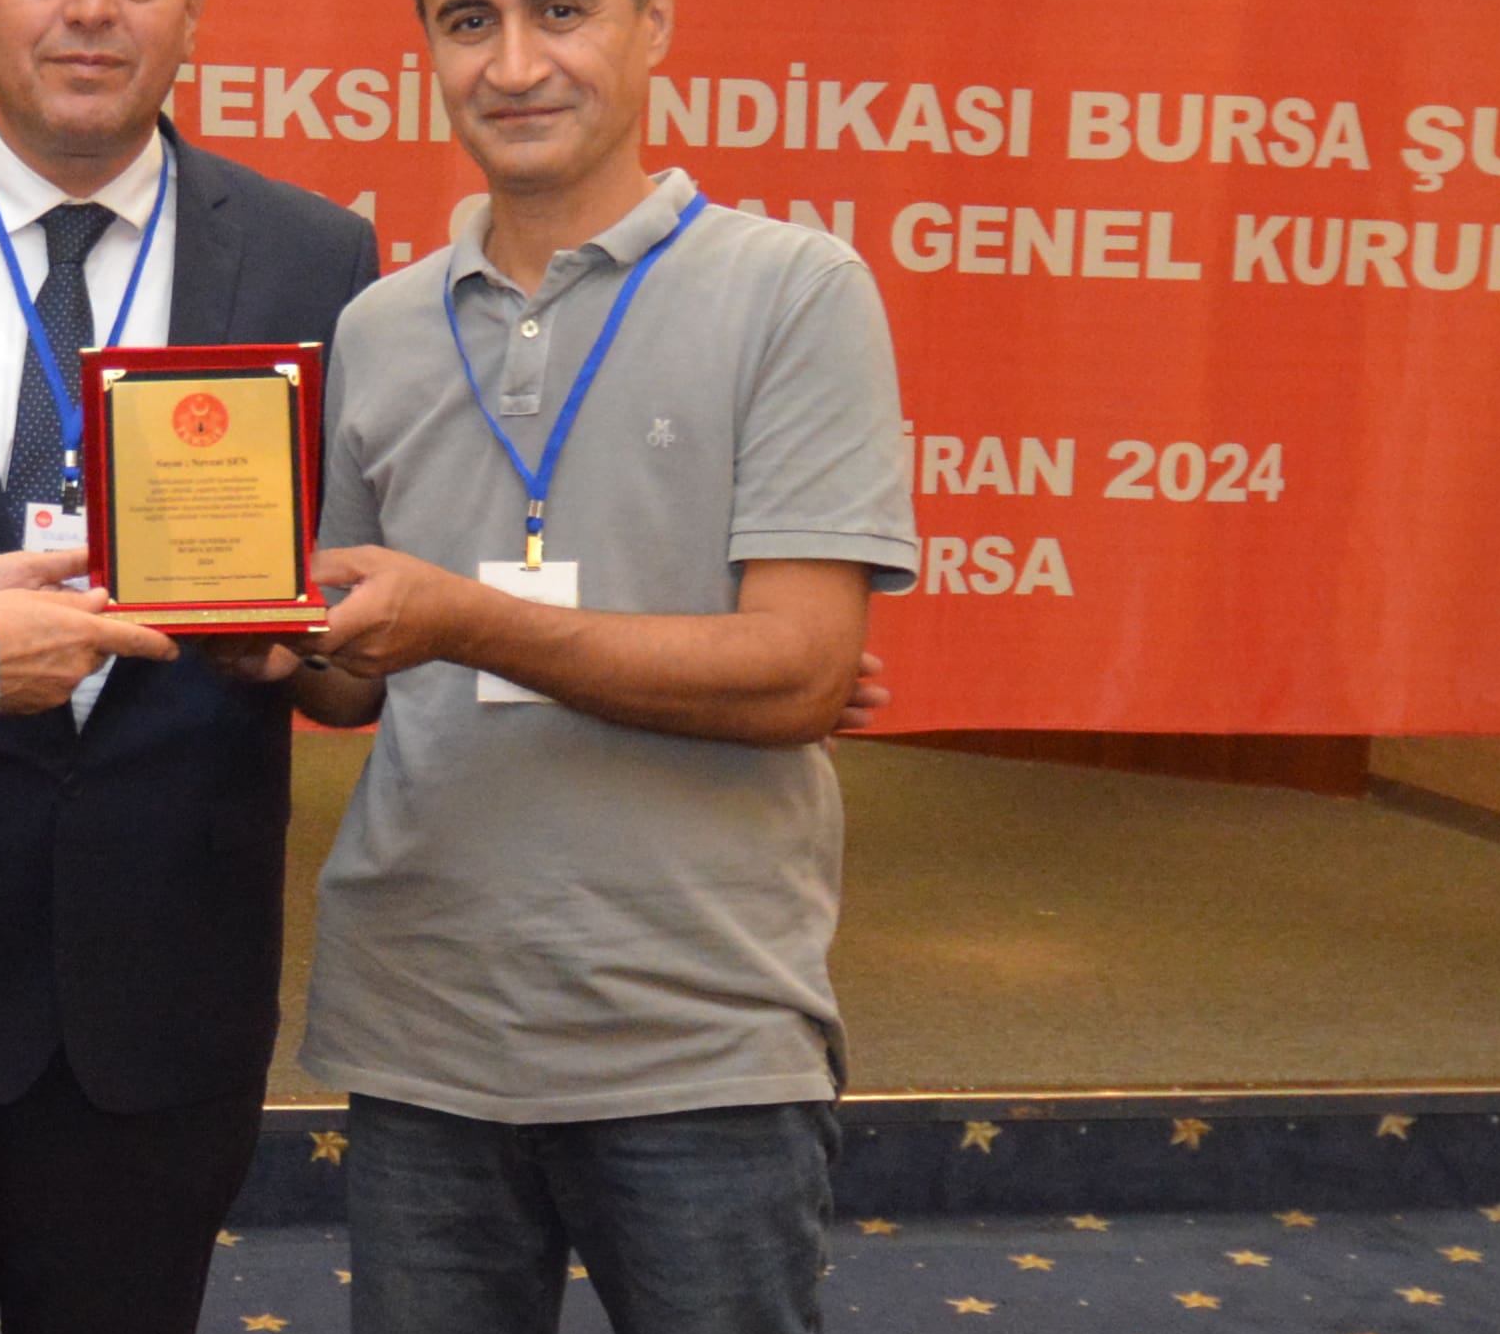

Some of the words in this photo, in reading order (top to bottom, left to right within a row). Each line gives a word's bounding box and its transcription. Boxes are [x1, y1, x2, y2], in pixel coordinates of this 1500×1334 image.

[647, 62, 1033, 158] NDİKASI
[1067, 90, 1370, 171] BURSA
[891, 202, 1202, 281] GENEL
[1103, 439, 1284, 502] 2024
